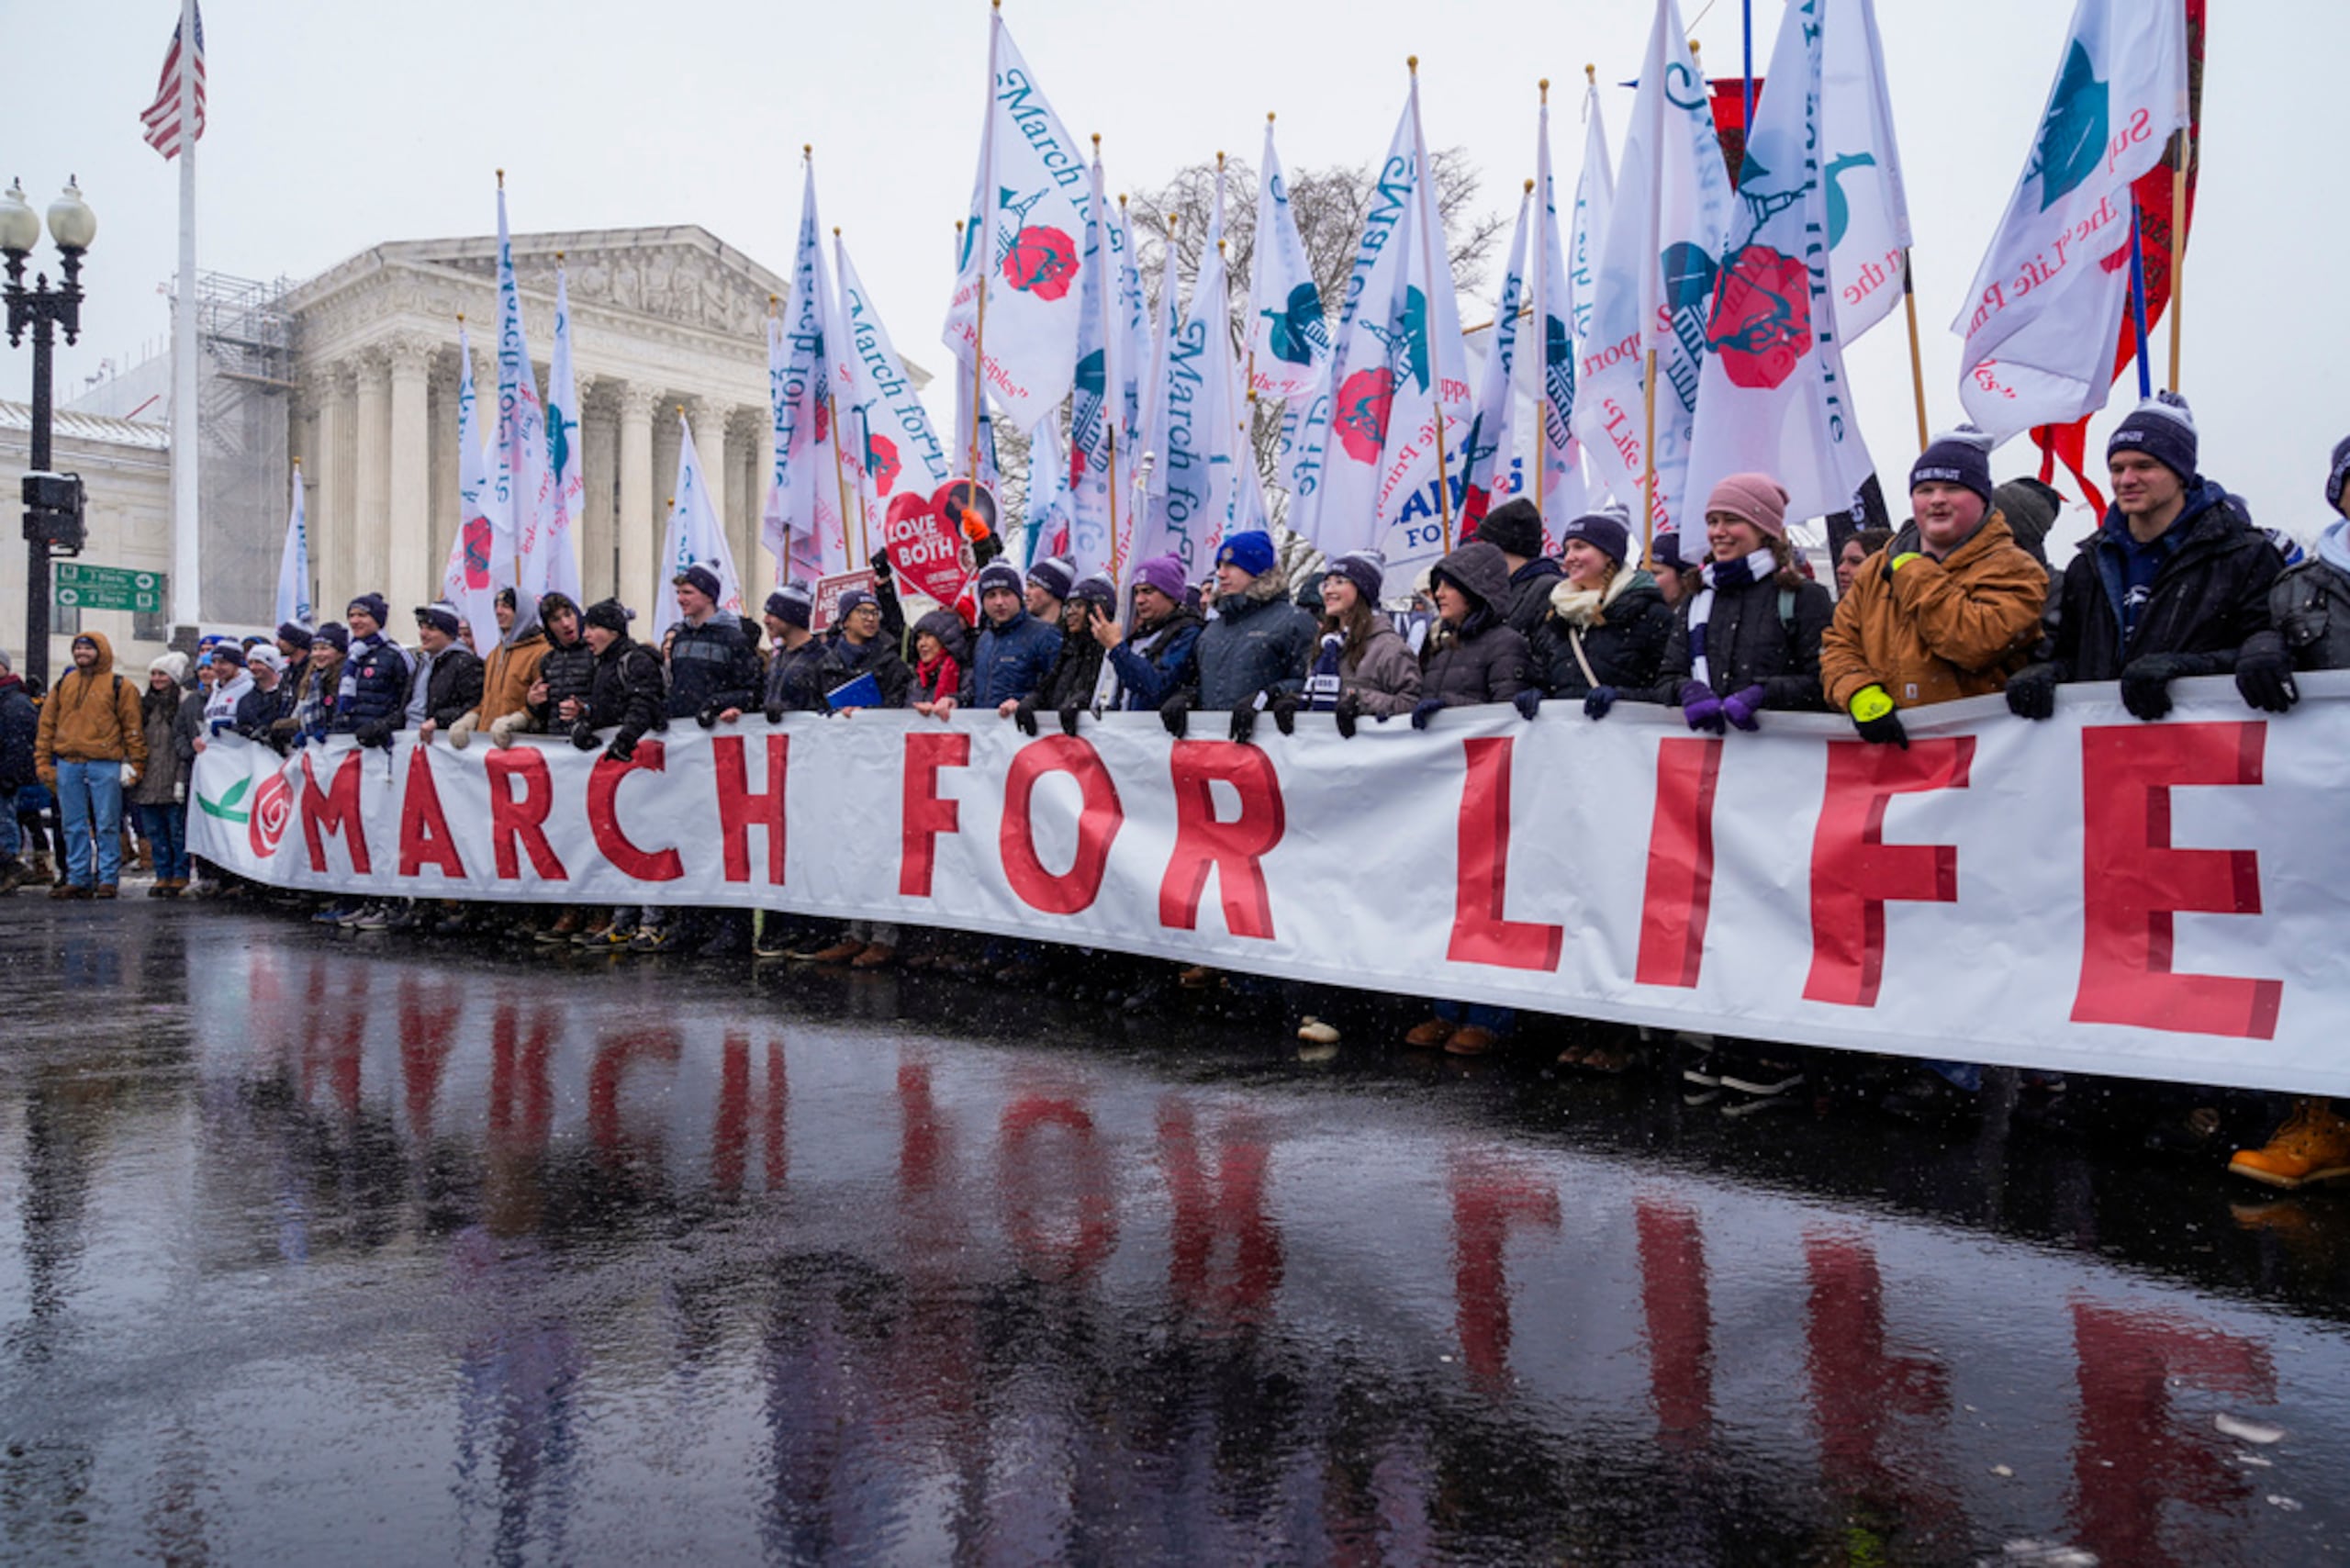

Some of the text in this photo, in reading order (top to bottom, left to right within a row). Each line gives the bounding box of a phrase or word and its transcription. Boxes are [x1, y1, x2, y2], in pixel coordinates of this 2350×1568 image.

[997, 68, 1085, 188] March
[893, 401, 934, 448] for
[1166, 319, 1205, 539] March for
[888, 513, 938, 543] LOVE
[898, 537, 955, 567] BOTH
[301, 720, 2283, 1039] MARCH FOR LIFE
